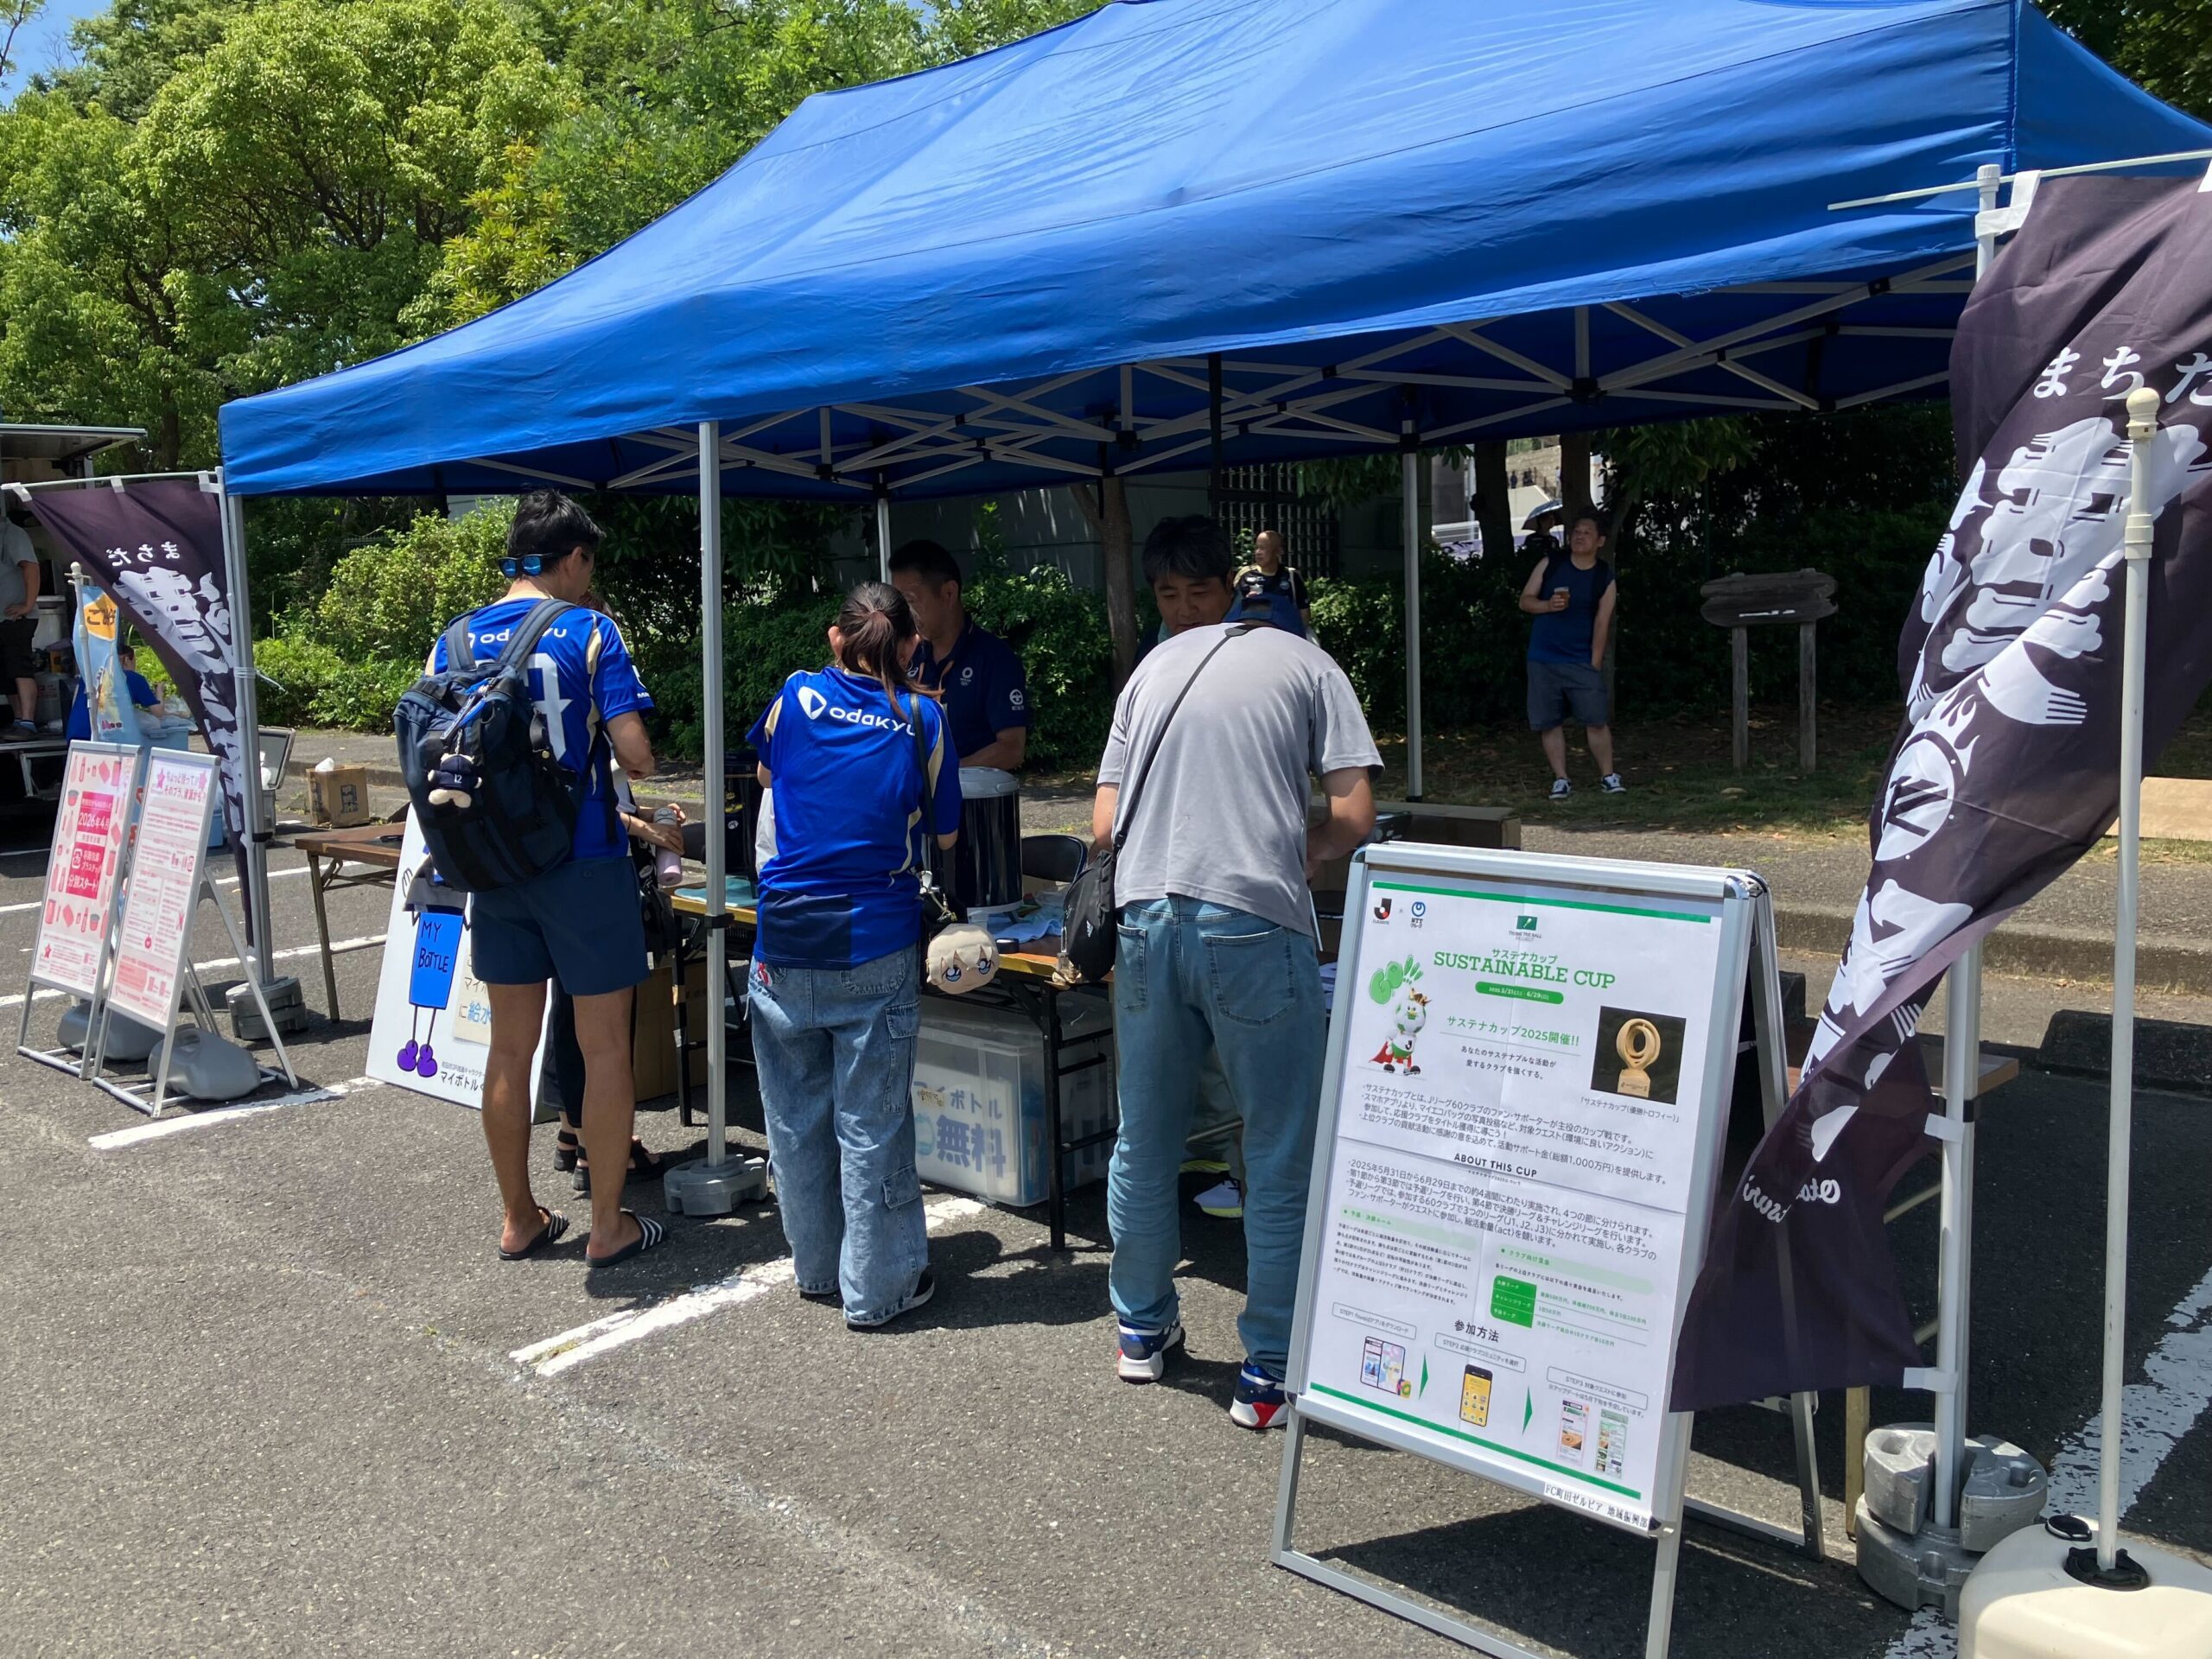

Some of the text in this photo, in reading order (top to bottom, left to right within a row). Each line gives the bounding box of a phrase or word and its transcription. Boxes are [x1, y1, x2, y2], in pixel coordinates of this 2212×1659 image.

[480, 628, 567, 644] odu
[421, 919, 442, 944] MY
[1491, 949, 1558, 964] サステナカップ
[1433, 951, 1616, 989] SUSTAINABLE CUP
[1460, 1046, 1557, 1068] あなたのサステナブルな活動が
[1466, 1059, 1543, 1080] 愛するクラブを強くする。
[914, 1081, 1002, 1121] ボトル
[936, 1114, 1007, 1179] 無料
[1454, 1153, 1537, 1179] ABOUT THIS CUP
[1454, 1319, 1500, 1344] 参加方法
